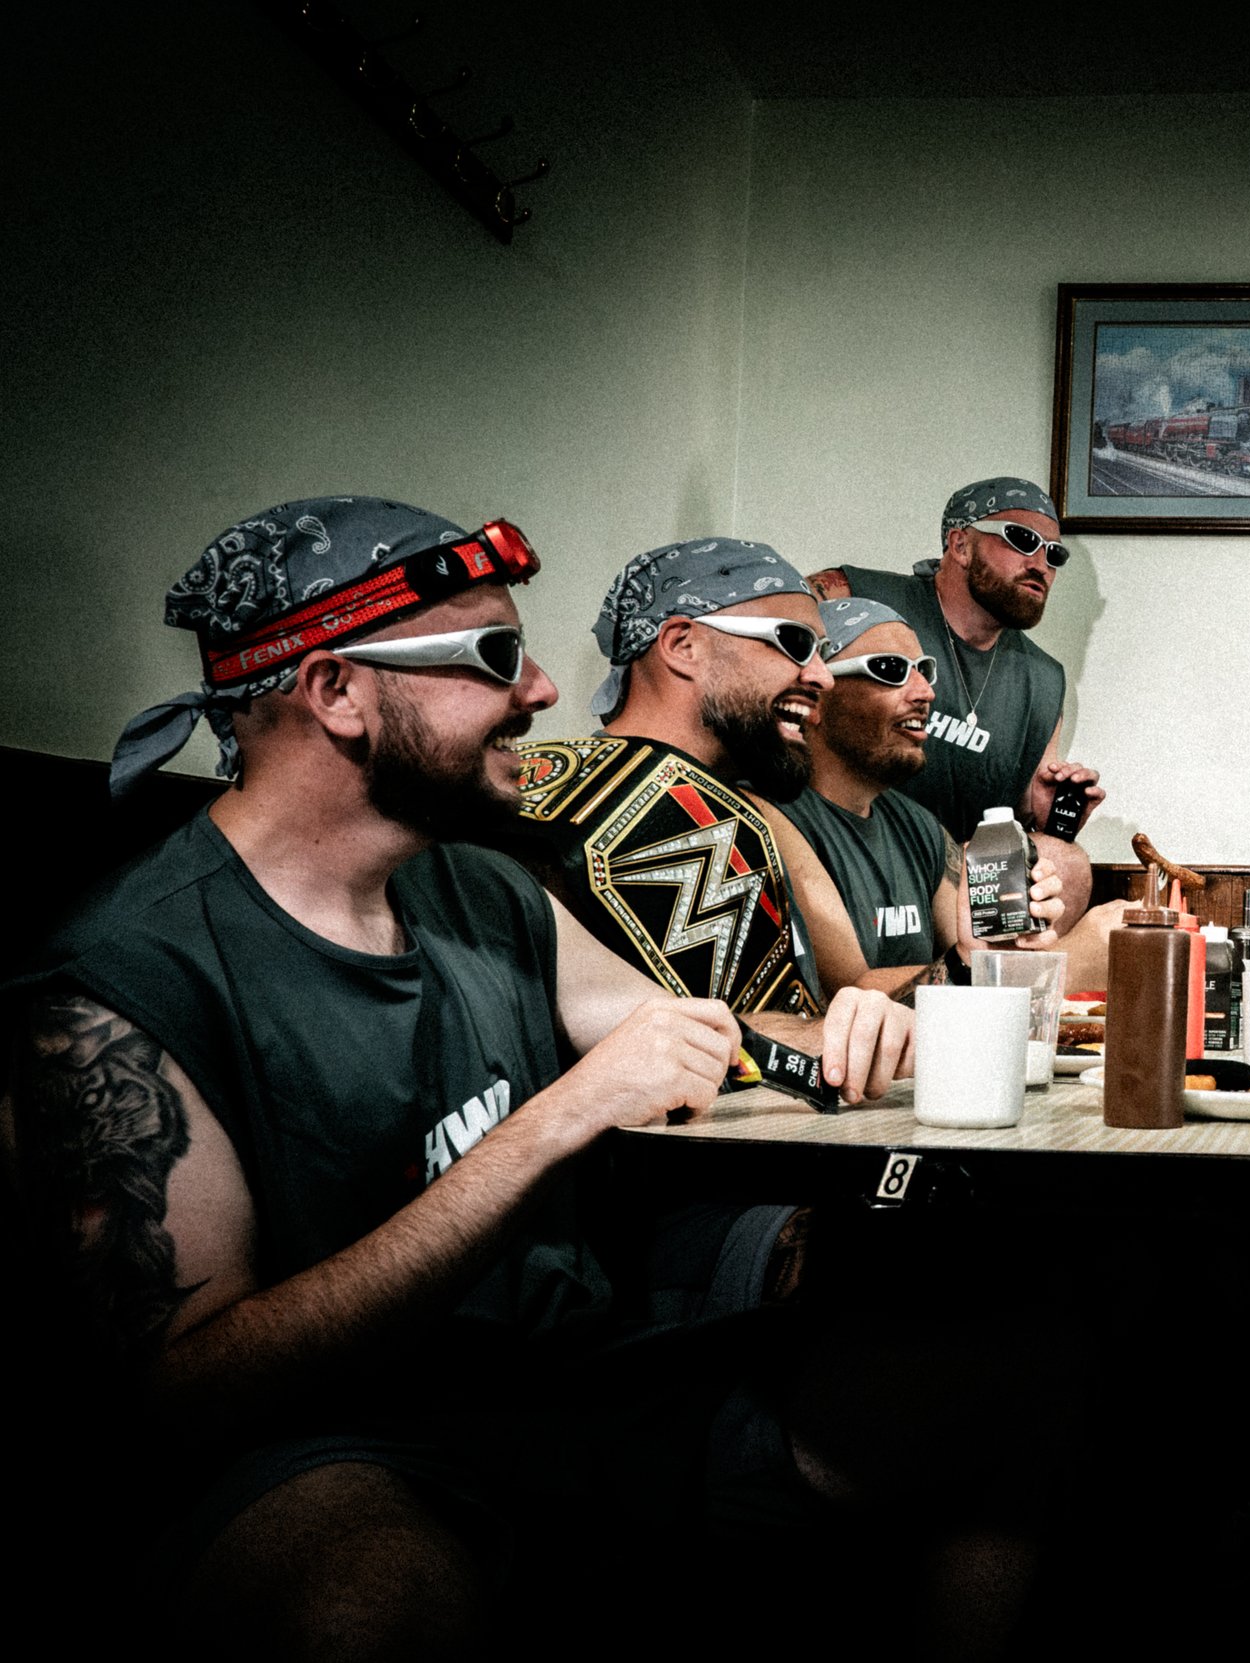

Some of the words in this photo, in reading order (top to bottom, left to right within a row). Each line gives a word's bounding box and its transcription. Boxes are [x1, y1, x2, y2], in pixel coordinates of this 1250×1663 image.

[239, 633, 305, 670] FENIX
[926, 710, 990, 753] HWD
[689, 771, 741, 810] CHAMPION
[967, 861, 1008, 875] WHOLE
[969, 884, 1000, 896] BODY
[970, 894, 999, 906] FUEL
[884, 1159, 909, 1195] 8
